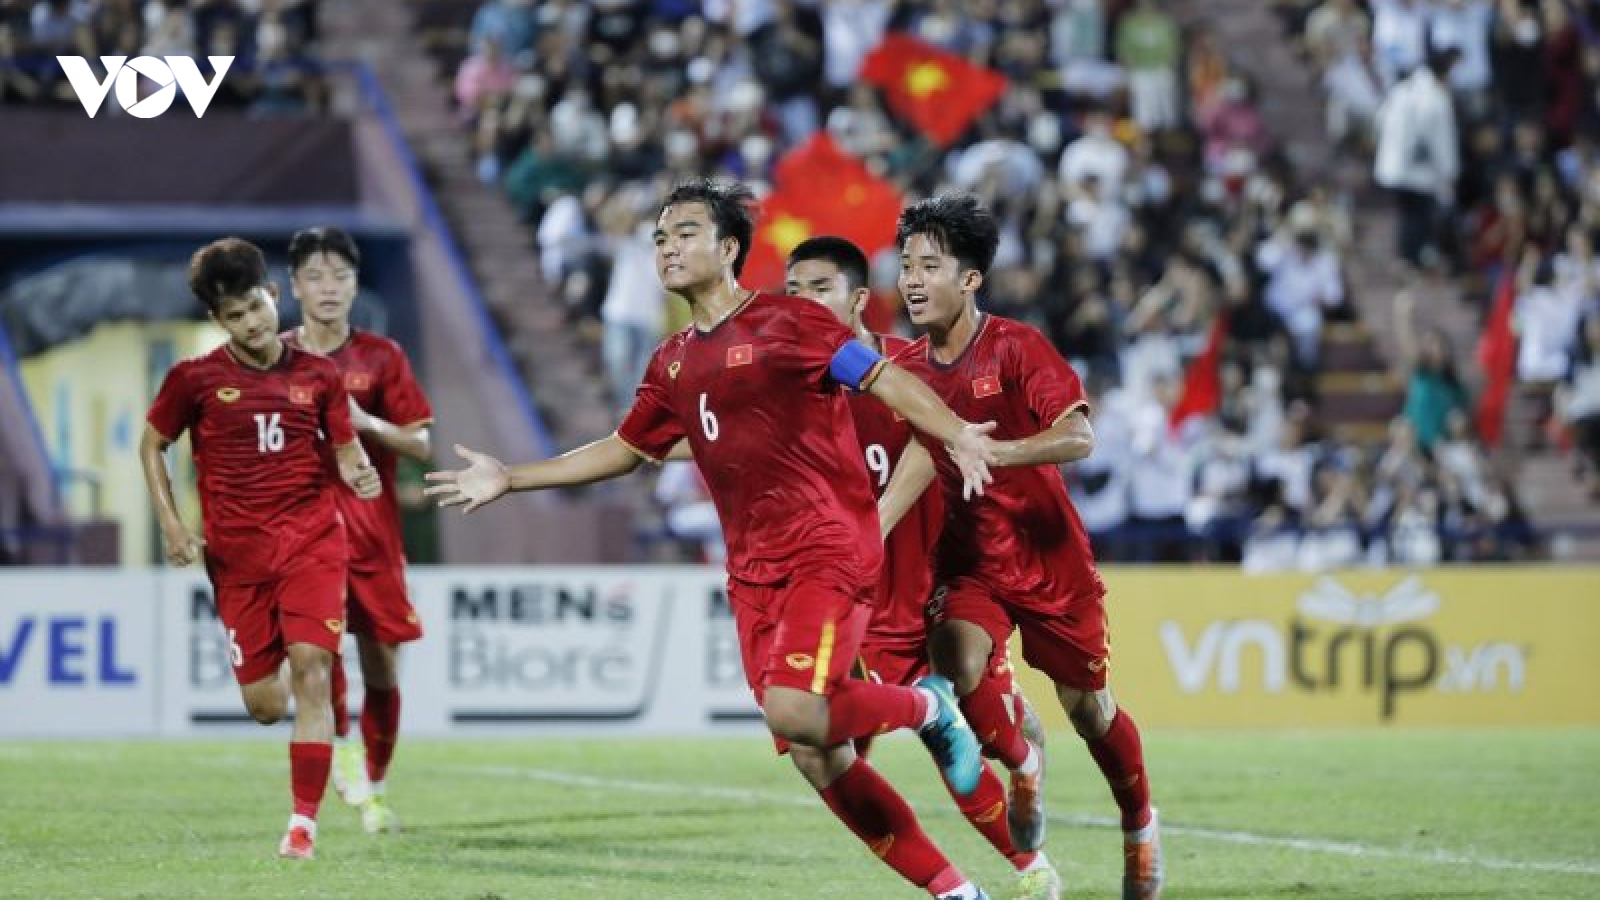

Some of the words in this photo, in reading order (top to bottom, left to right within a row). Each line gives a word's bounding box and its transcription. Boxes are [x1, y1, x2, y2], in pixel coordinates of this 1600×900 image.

[253, 413, 282, 453] 16
[699, 393, 719, 442] 6
[865, 443, 889, 487] 9
